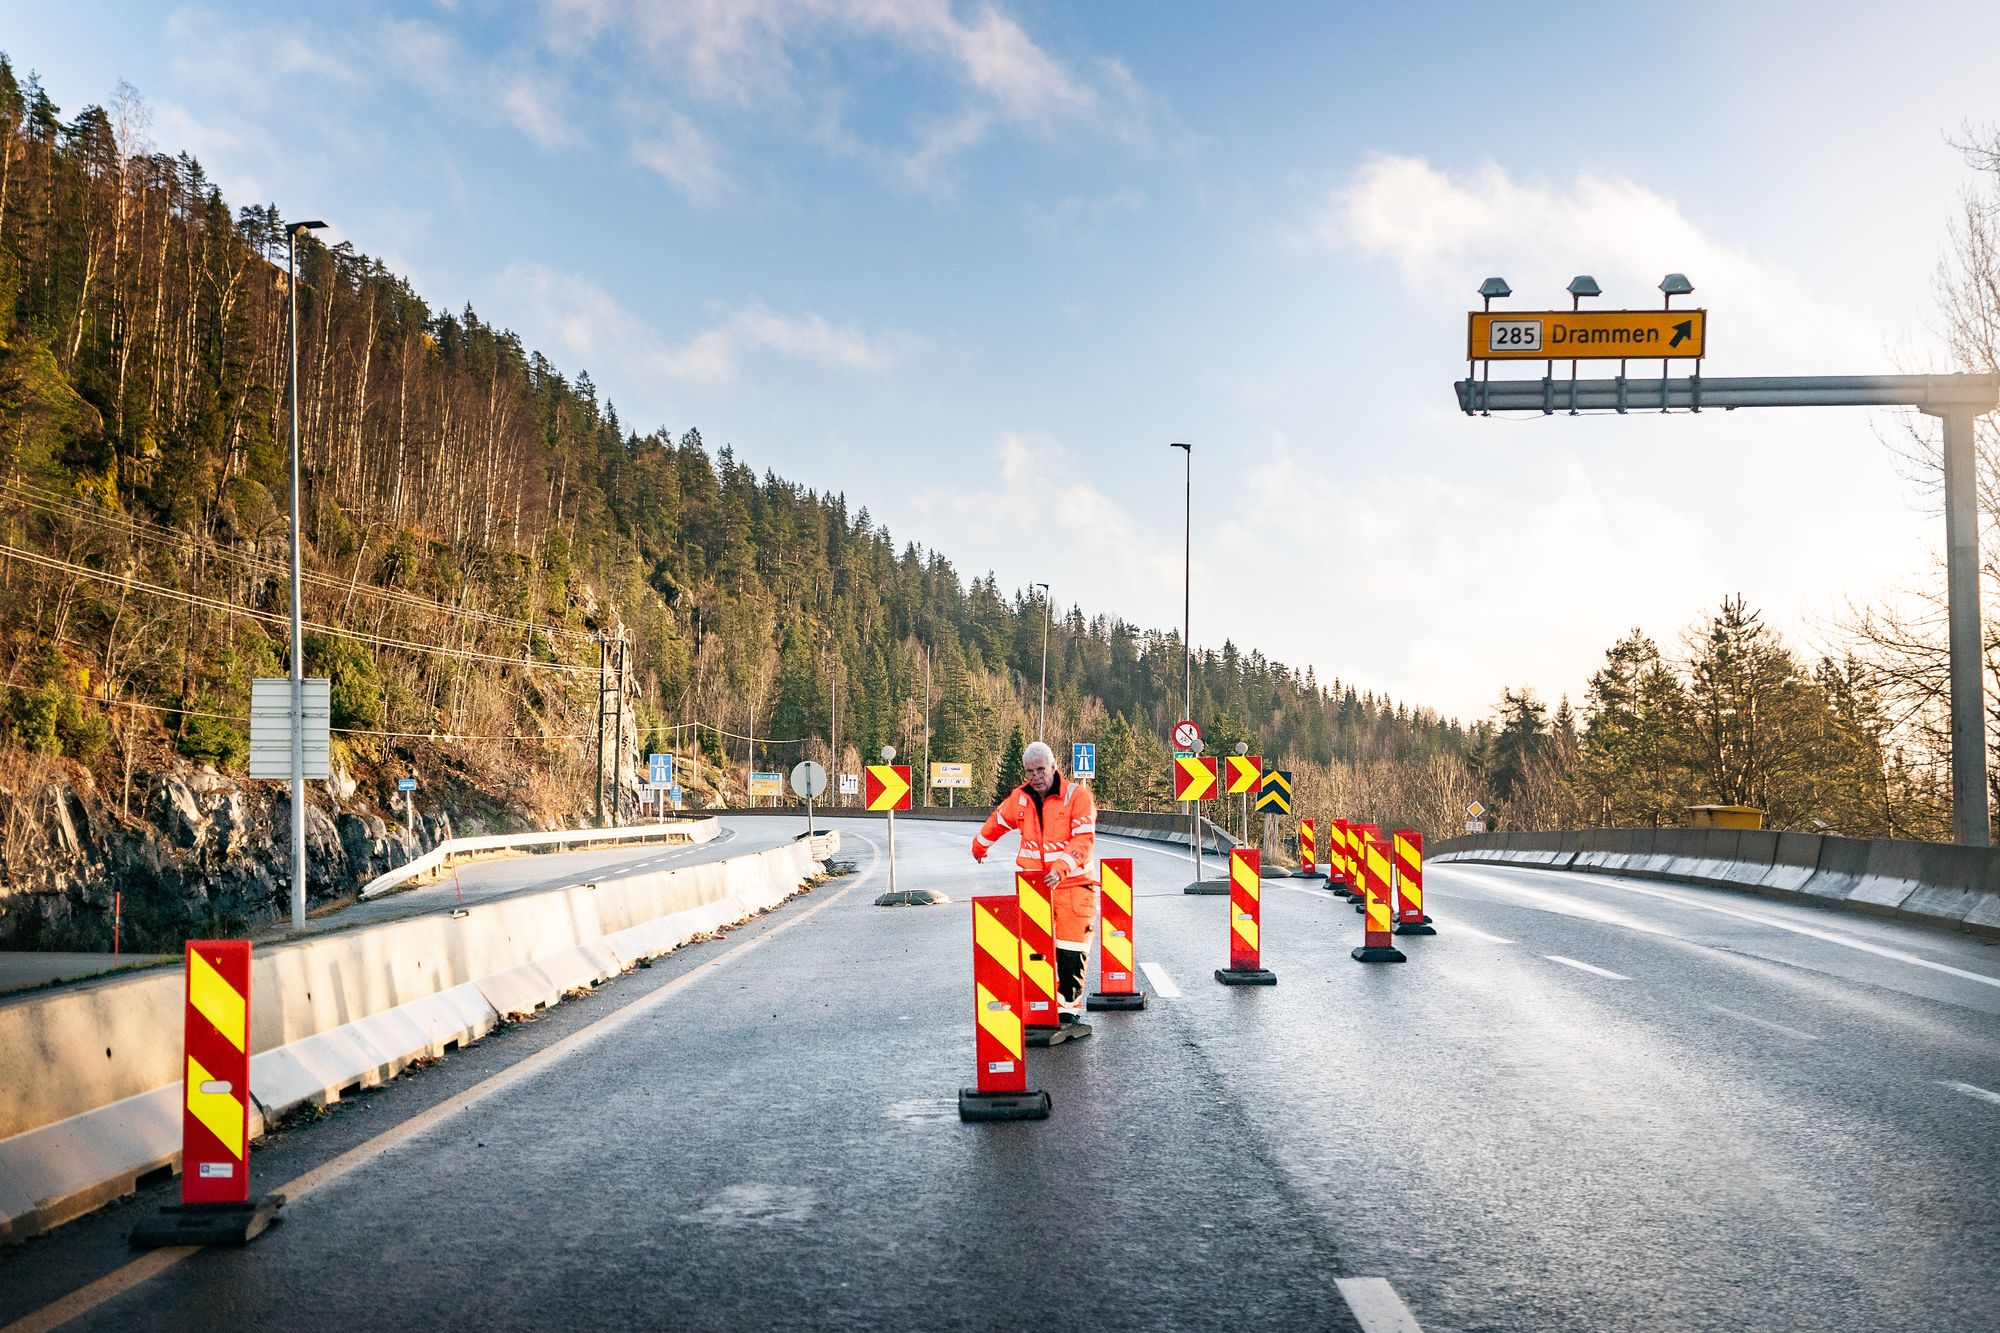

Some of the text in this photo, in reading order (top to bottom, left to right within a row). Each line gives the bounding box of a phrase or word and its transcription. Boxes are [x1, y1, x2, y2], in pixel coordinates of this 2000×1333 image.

[1496, 324, 1659, 345] 285 Drammen
[1467, 822, 1482, 830] 285
